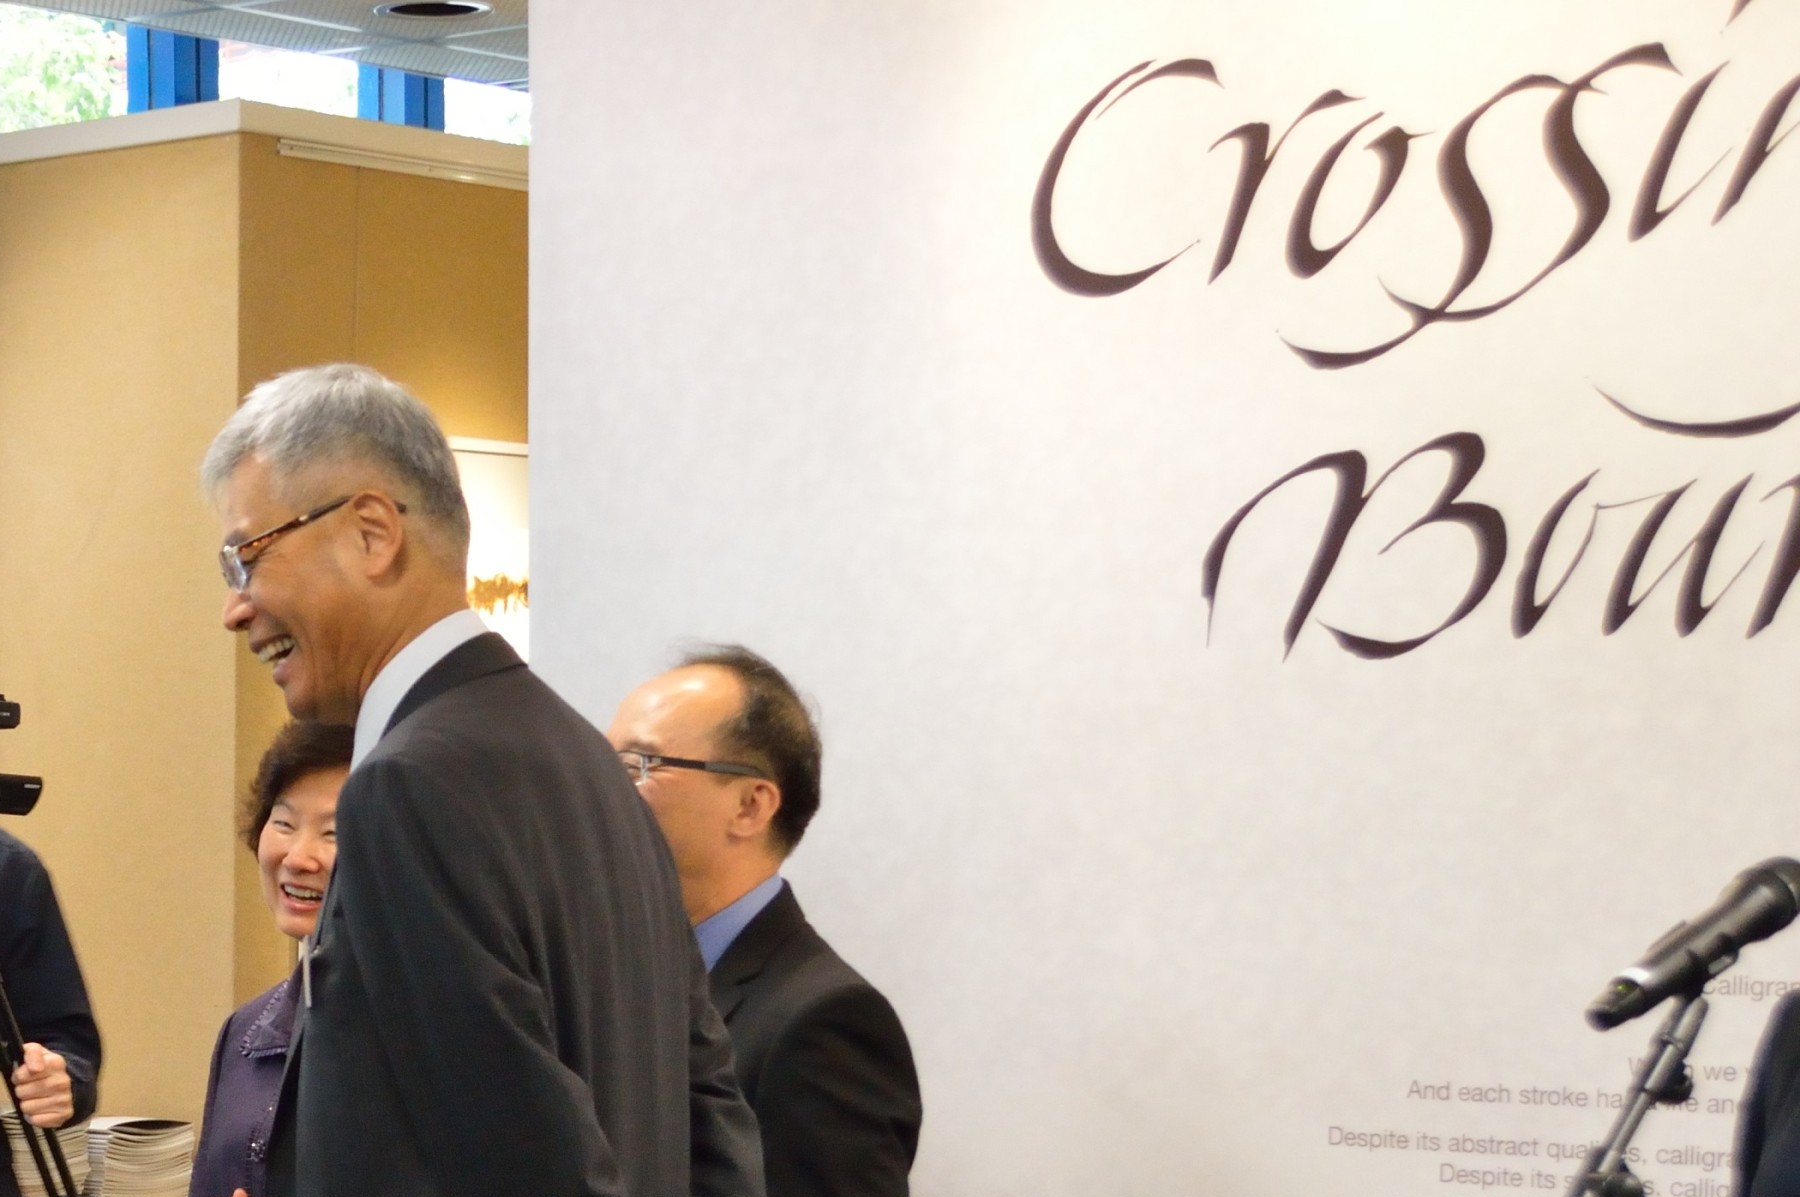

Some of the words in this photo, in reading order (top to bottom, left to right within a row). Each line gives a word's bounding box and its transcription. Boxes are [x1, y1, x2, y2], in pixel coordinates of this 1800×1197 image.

[1703, 1064, 1737, 1082] we
[1406, 1079, 1451, 1101] And
[1457, 1083, 1510, 1105] each
[1518, 1086, 1588, 1109] stroke
[1328, 1126, 1408, 1153] Despite
[1416, 1131, 1440, 1152] its
[1447, 1134, 1539, 1158] abstract
[1439, 1162, 1523, 1191] Despite
[1531, 1168, 1556, 1190] its
